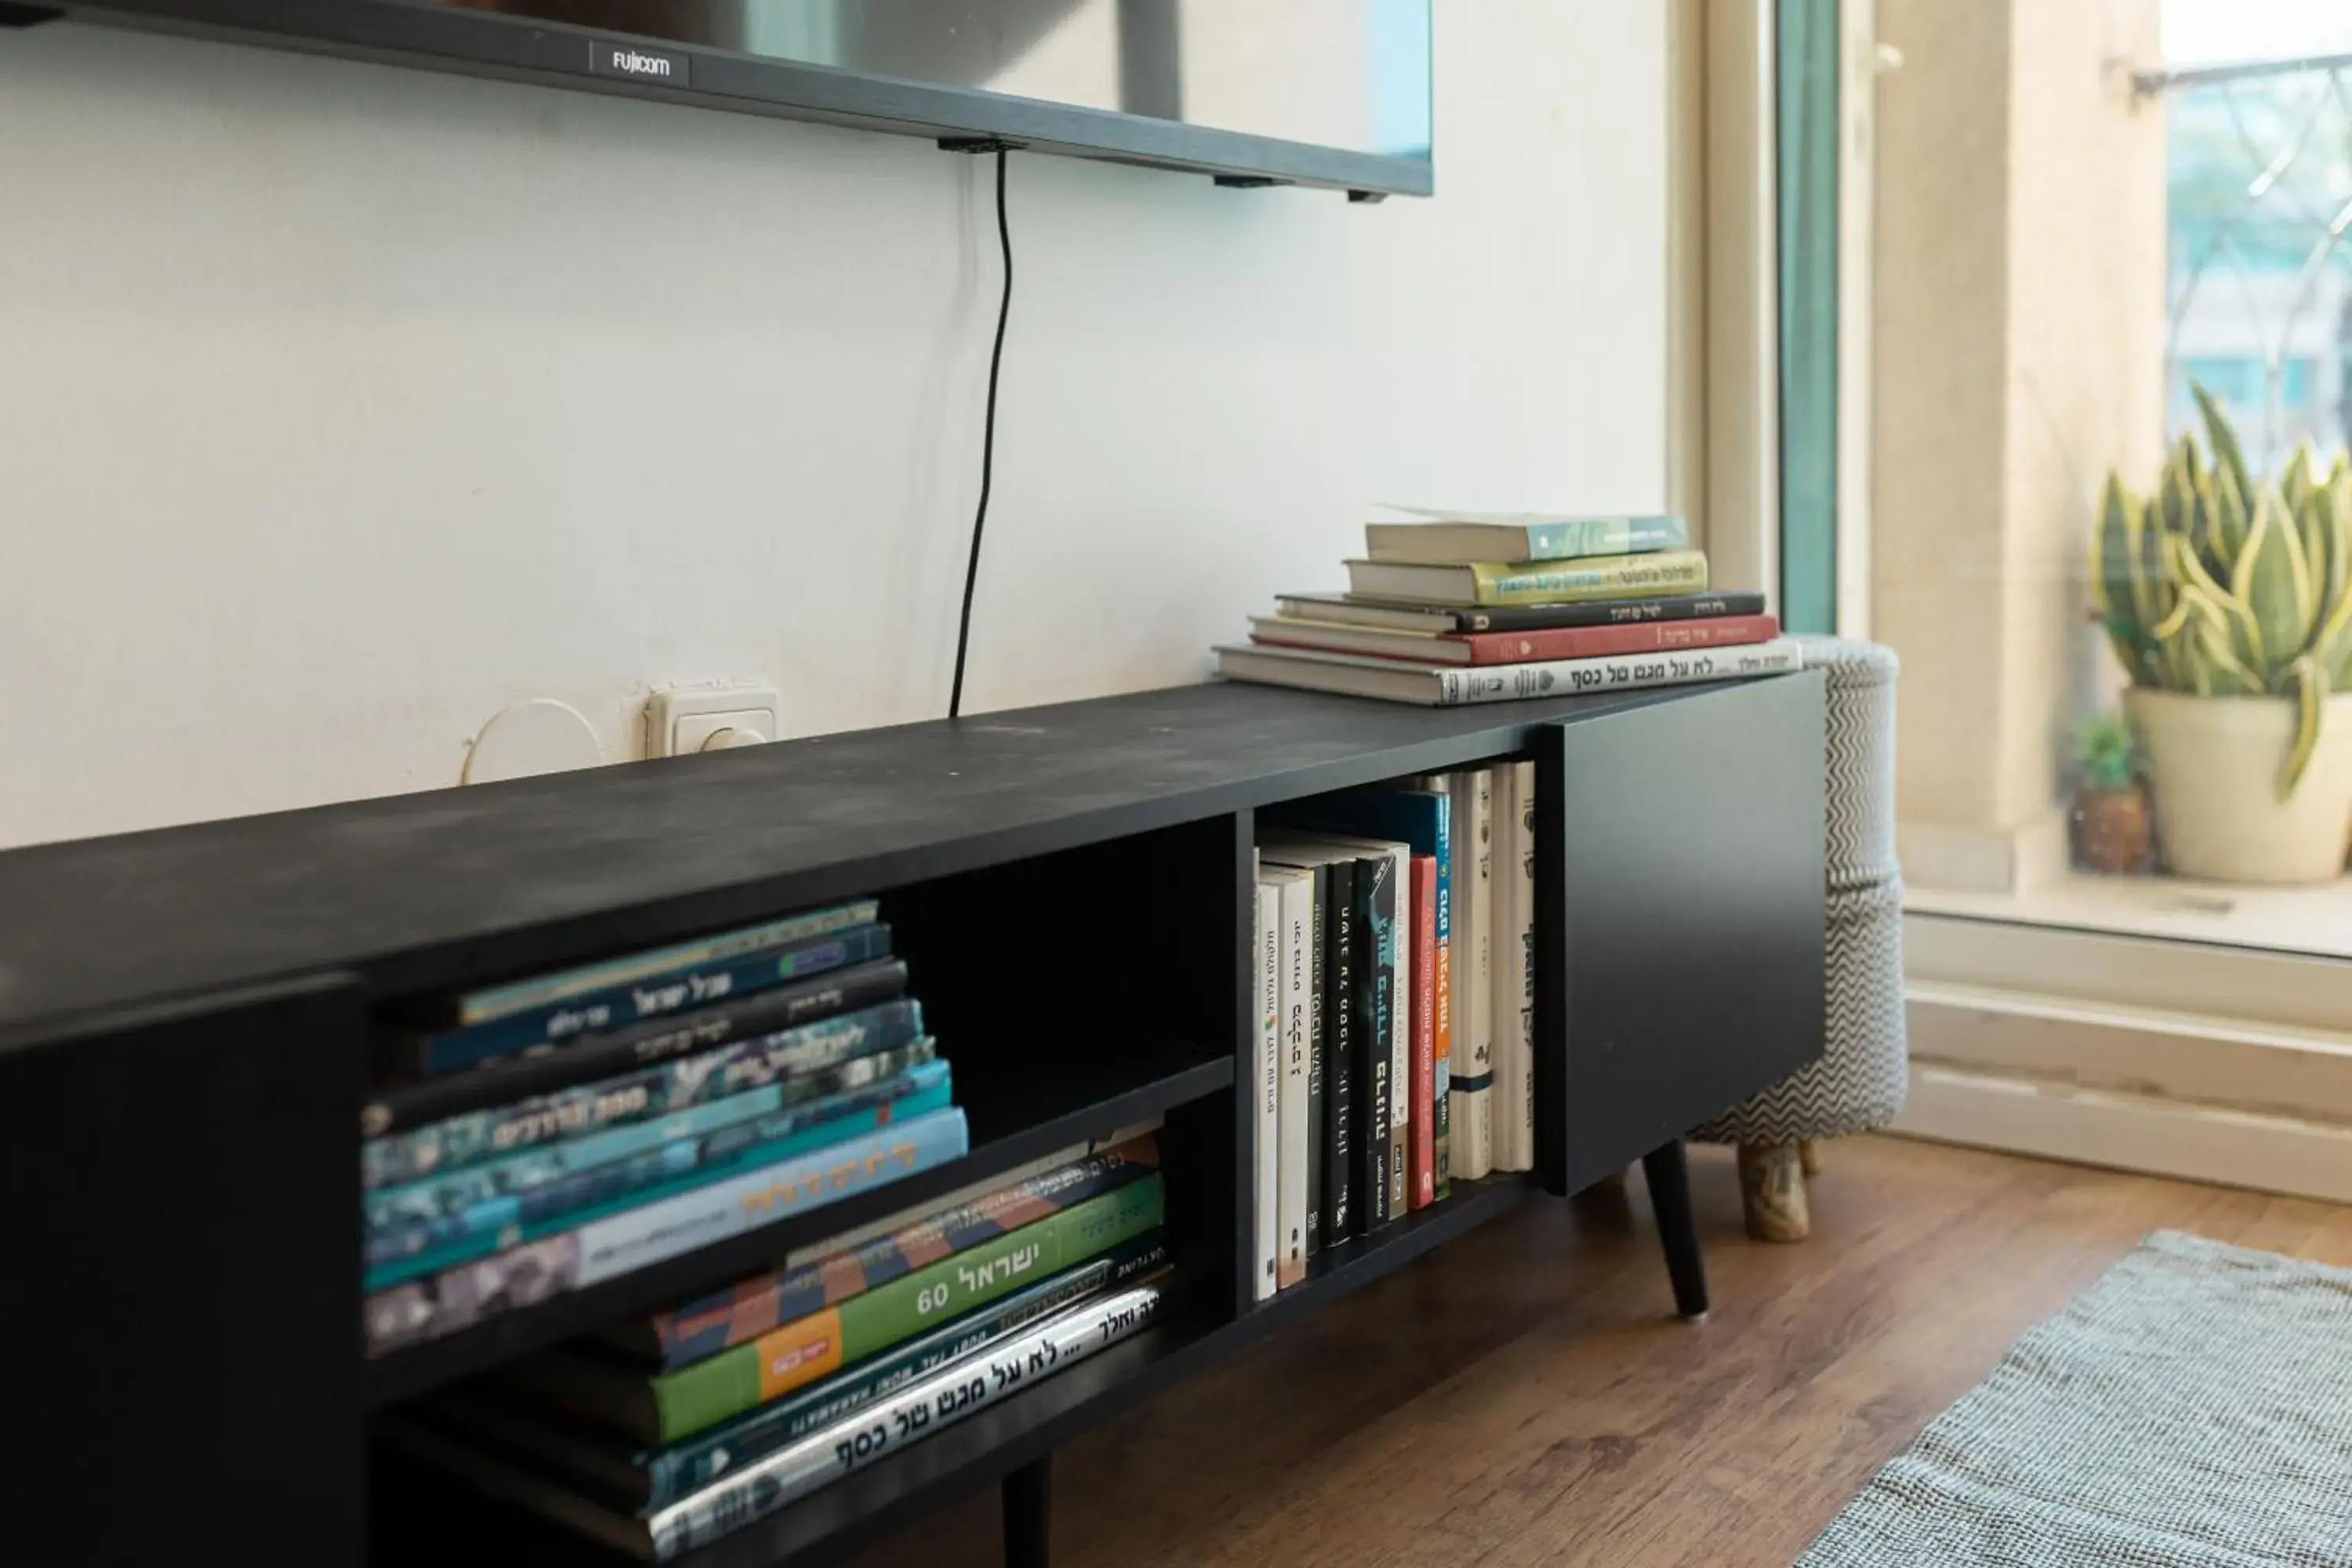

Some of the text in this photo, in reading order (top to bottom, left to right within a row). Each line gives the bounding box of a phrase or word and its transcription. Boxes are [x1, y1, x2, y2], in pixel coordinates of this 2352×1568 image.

[1570, 670, 1602, 689] כסף
[1607, 664, 1628, 684] של
[1634, 665, 1664, 681] מגש
[1669, 659, 1689, 678] על
[1293, 949, 1301, 991] ברנדס
[1338, 906, 1349, 1051] חשוב על מספר
[1287, 1004, 1301, 1064] מלכים
[1376, 1060, 1386, 1140] פרנויה
[916, 1246, 1040, 1316] ישראל 60
[1098, 1307, 1134, 1341] ואלך
[991, 1356, 1022, 1396] על
[1029, 1340, 1058, 1374] לא
[938, 1380, 986, 1418] מגש
[894, 1400, 930, 1439] של
[835, 1431, 888, 1468] כסף
